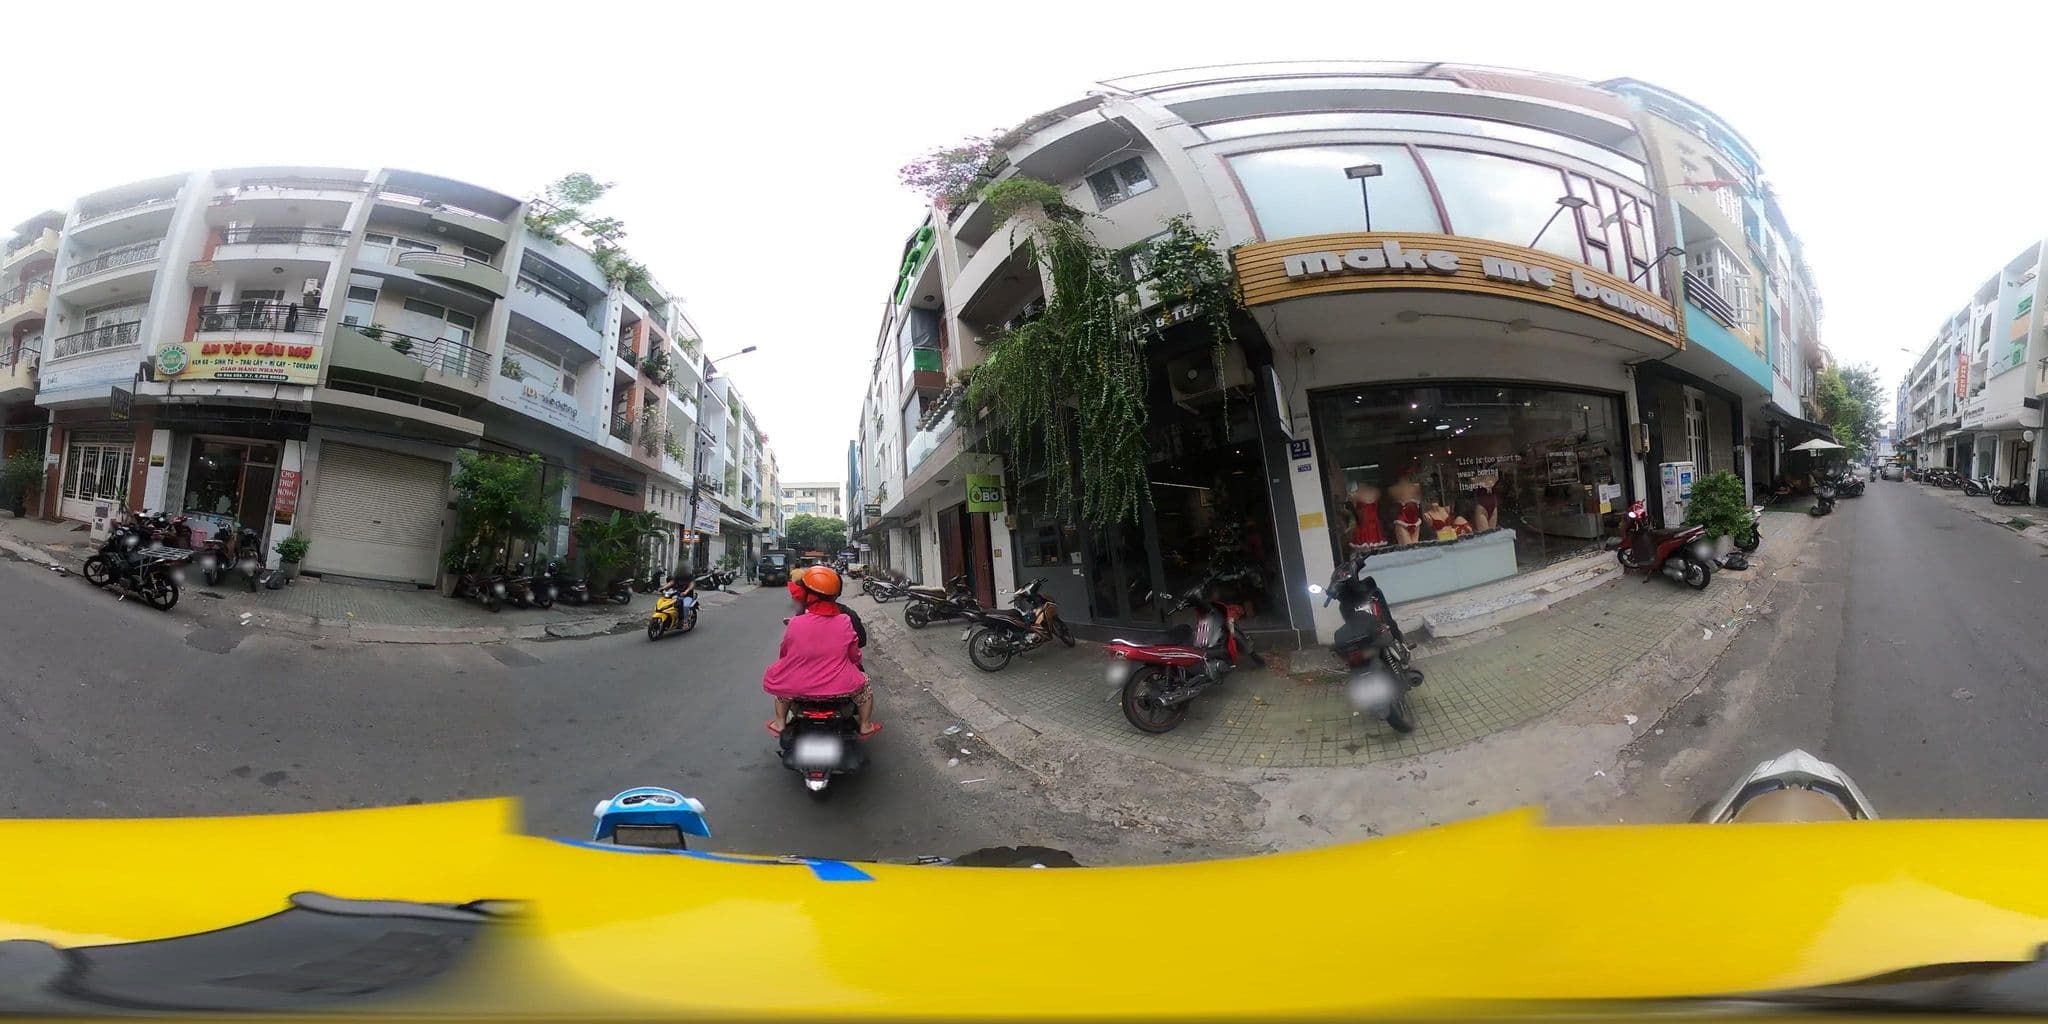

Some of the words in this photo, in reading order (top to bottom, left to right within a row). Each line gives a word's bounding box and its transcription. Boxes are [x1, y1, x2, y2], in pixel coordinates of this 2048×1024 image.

[1283, 240, 1459, 281] make
[1481, 255, 1556, 289] me
[1570, 267, 1677, 335] banana
[1293, 441, 1308, 453] 21
